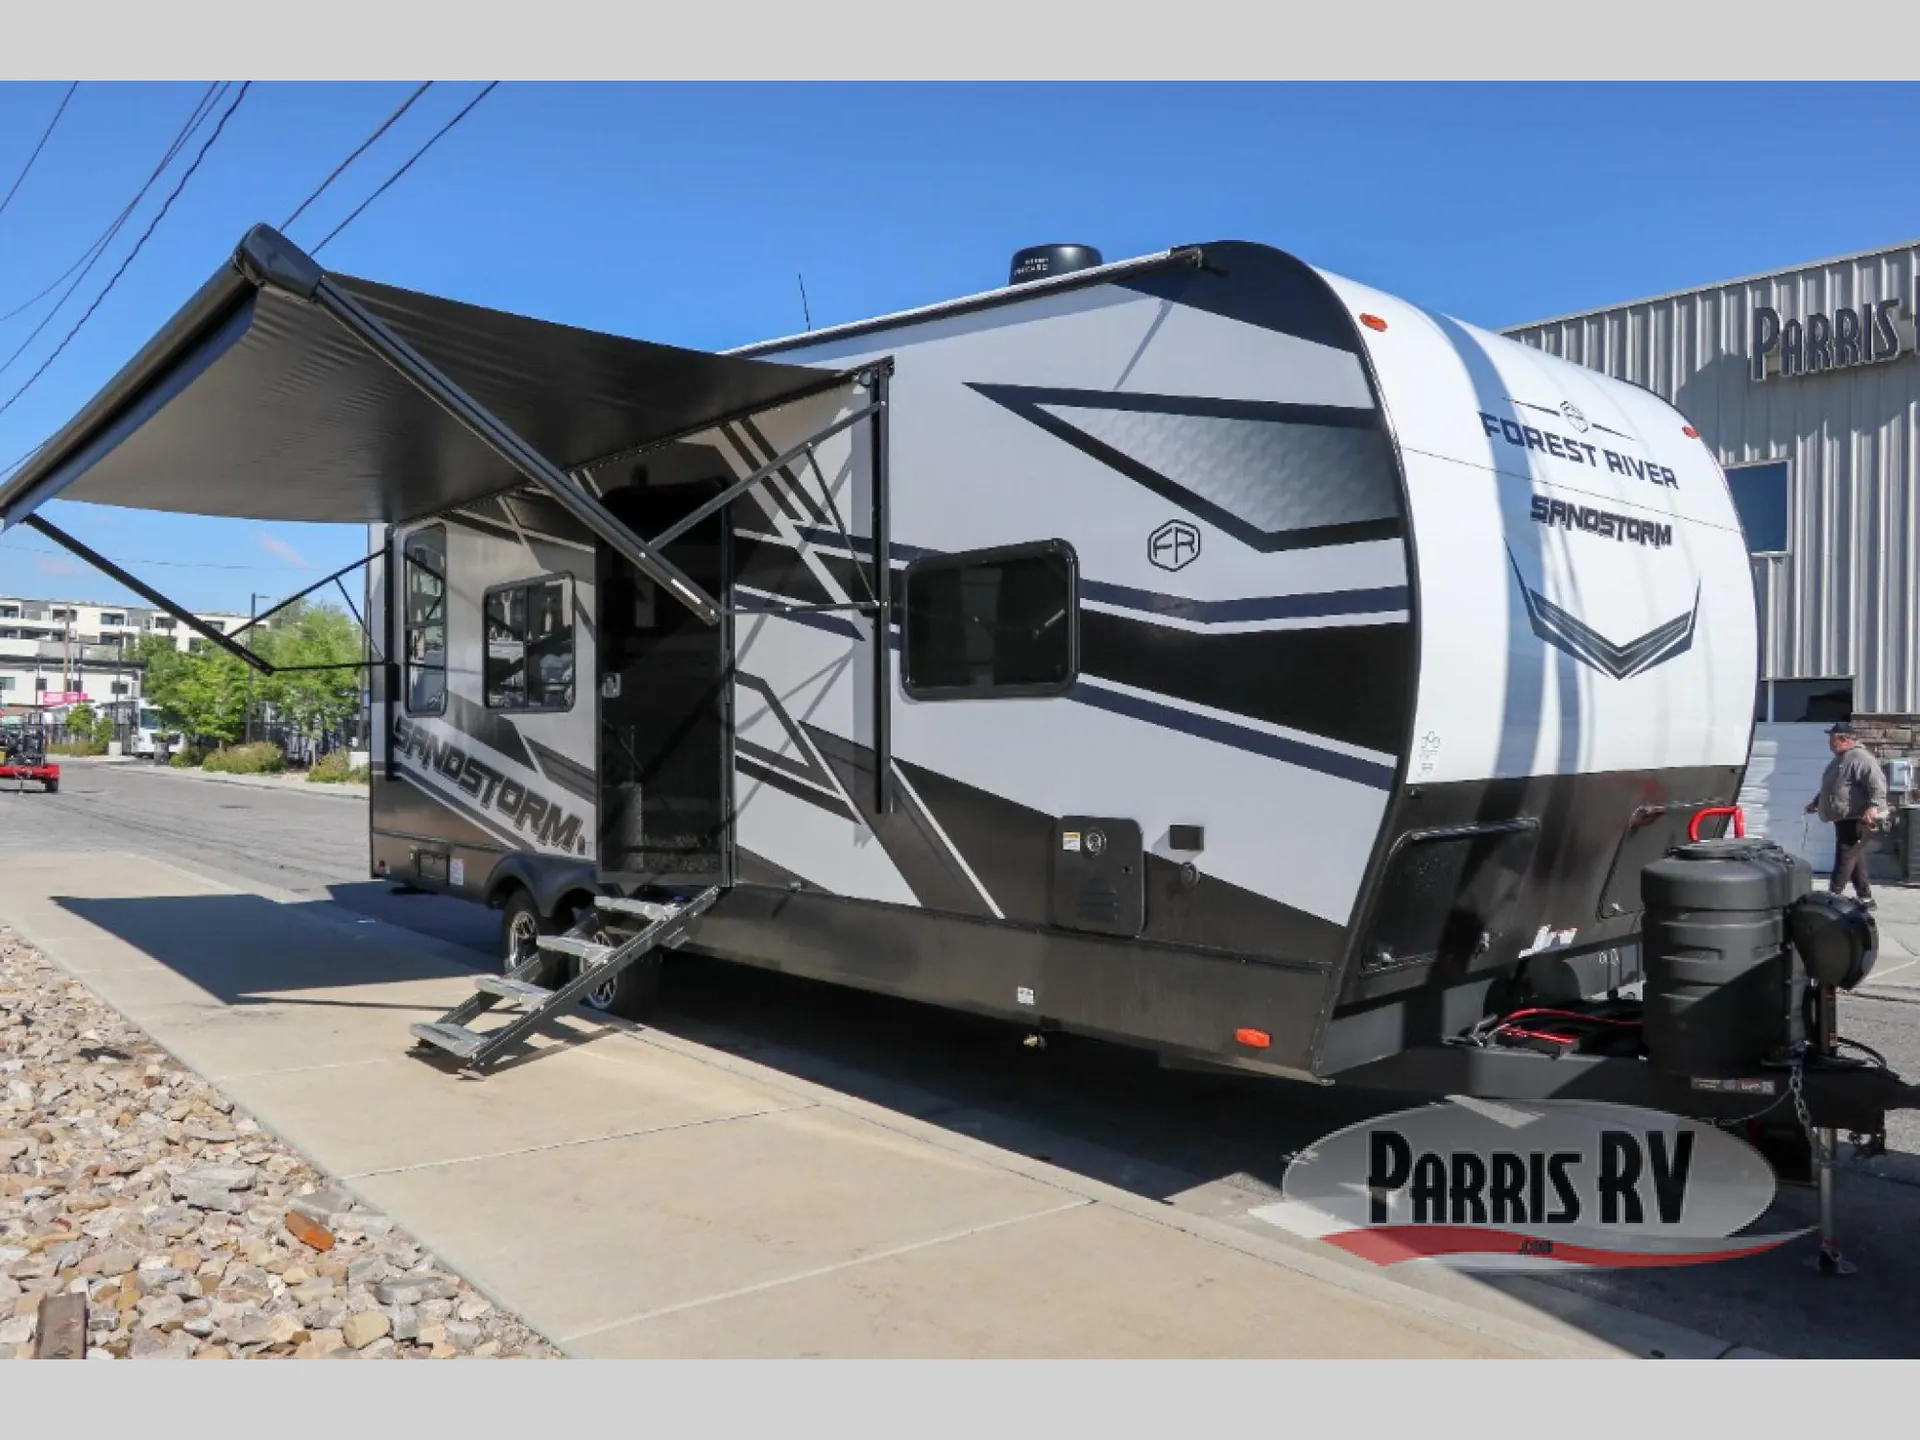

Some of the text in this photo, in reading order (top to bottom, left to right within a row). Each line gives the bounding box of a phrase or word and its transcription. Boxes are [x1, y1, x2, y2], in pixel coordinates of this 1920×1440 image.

[1751, 298, 1901, 382] PARRIS
[1478, 411, 1679, 490] FOREST RIVER
[1151, 525, 1197, 567] FR
[1531, 494, 1672, 549] SANDSTORM
[393, 716, 584, 853] SANDSTORM
